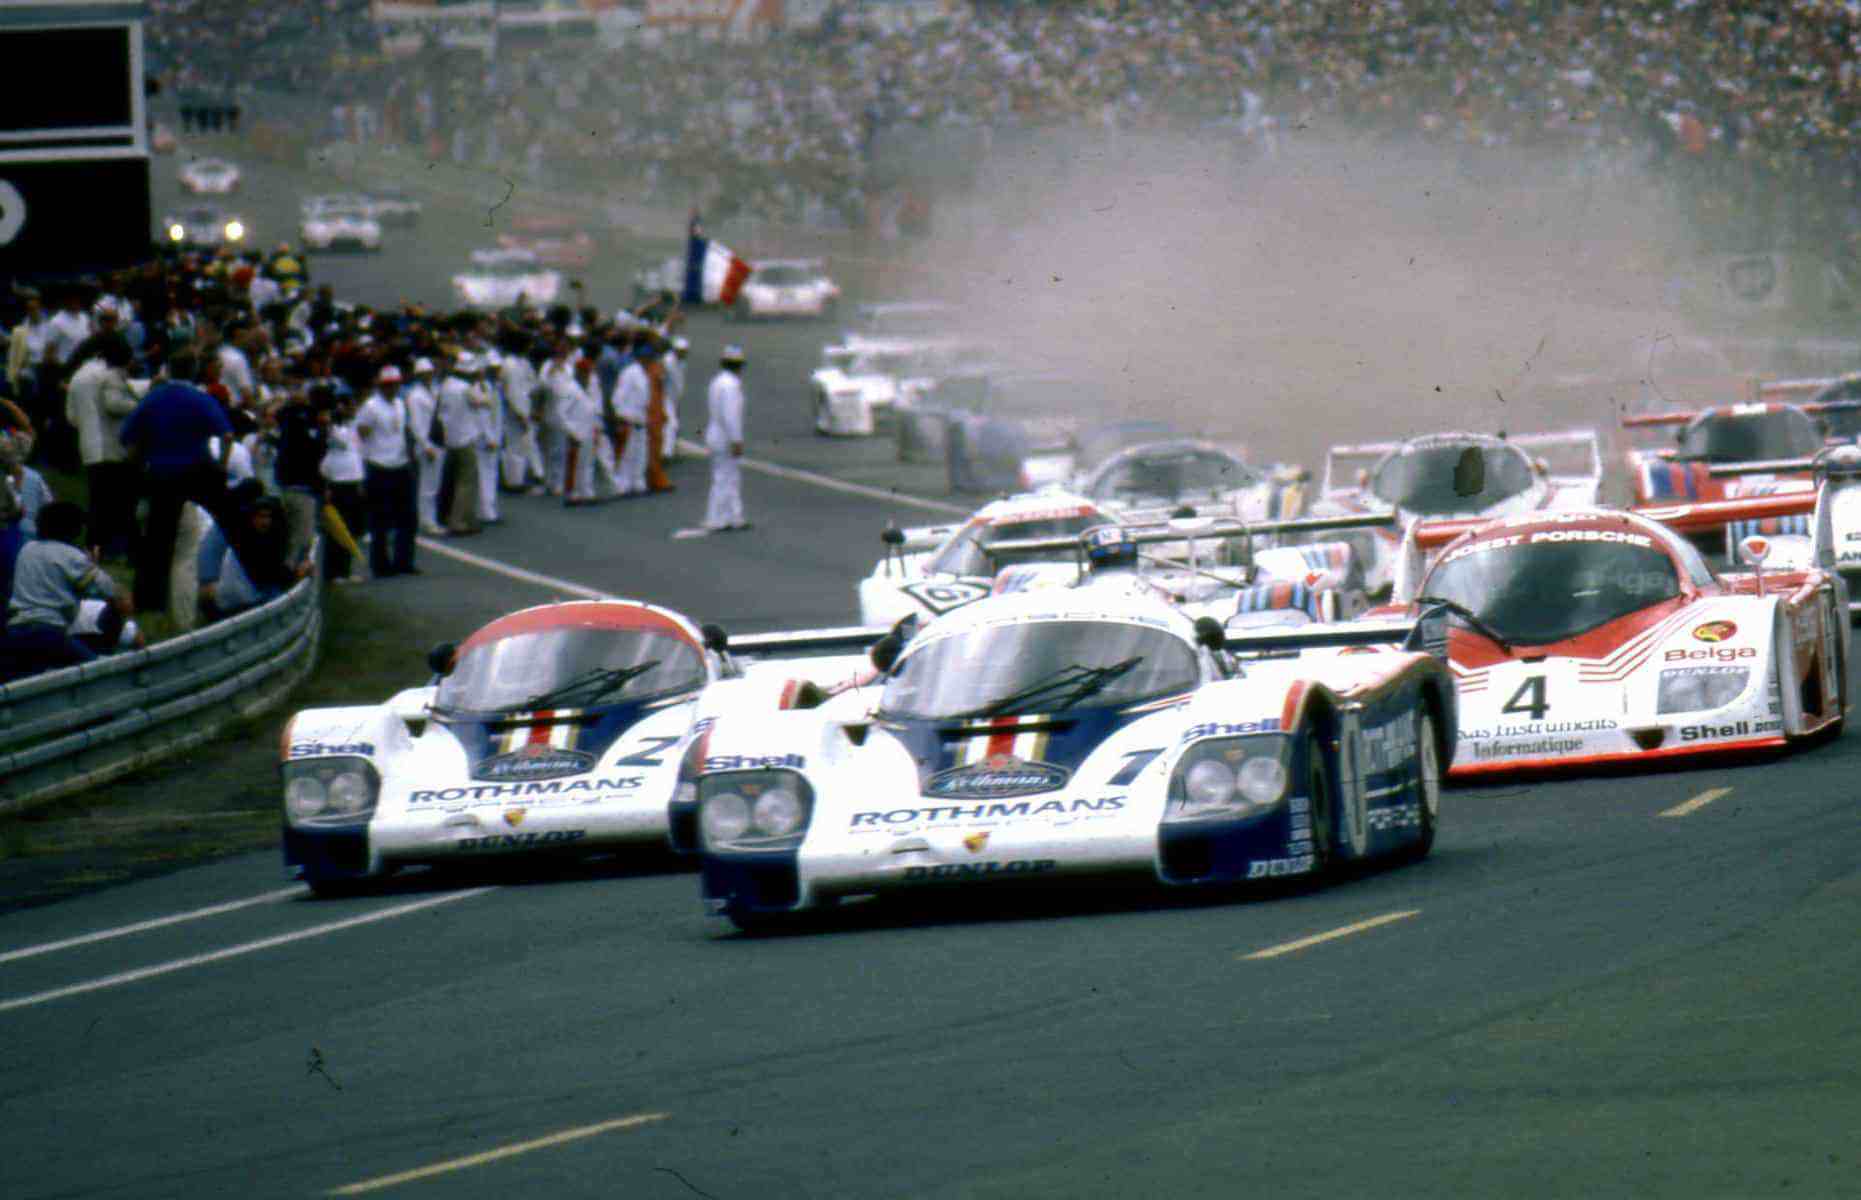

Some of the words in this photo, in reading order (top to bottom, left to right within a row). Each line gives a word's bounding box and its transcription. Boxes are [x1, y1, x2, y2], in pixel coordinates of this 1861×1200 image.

[1531, 529, 1652, 547] PORSCHE
[1664, 648, 1757, 661] Belga
[1502, 675, 1550, 720] 4
[1184, 718, 1282, 741] Shell
[1680, 721, 1749, 740] Shell
[289, 743, 375, 757] Shell
[616, 735, 681, 767] 2
[1472, 736, 1584, 758] Informatique
[704, 754, 805, 770] Shell
[1107, 747, 1167, 786] 1
[408, 775, 646, 803] ROTHMANS
[850, 795, 1128, 826] ROTHMANS
[458, 829, 588, 851] DUNLOP
[902, 858, 1056, 881] DUNLOP
